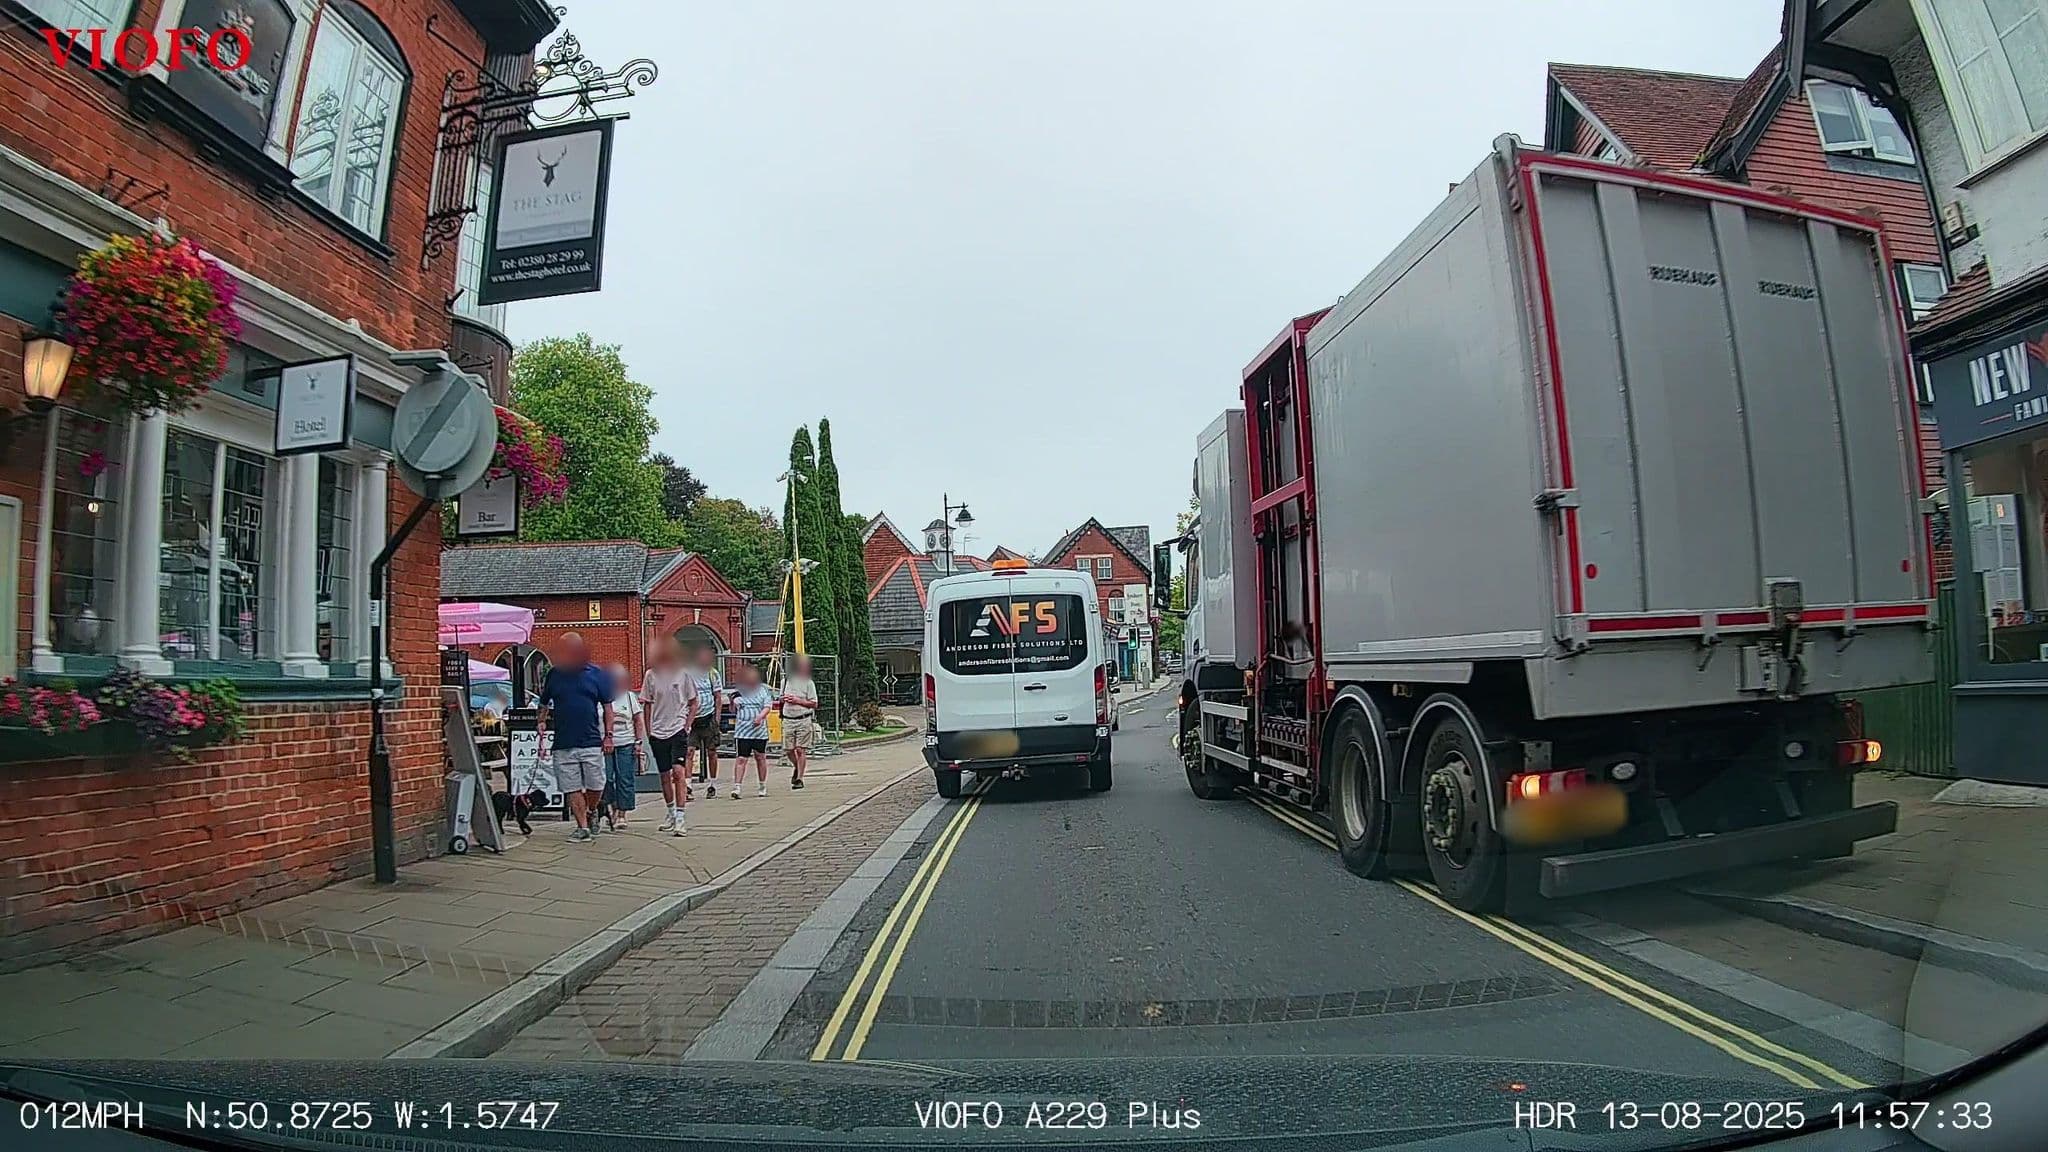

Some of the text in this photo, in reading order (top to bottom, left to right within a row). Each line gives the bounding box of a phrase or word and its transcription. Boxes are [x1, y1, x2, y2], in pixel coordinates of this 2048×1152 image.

[513, 191, 583, 211] THE STAG
[1968, 341, 2031, 407] NEW
[294, 416, 327, 434] Hotel
[477, 511, 497, 523] Bar
[970, 601, 1058, 637] AFS
[946, 644, 989, 652] ANDERSON
[1020, 640, 1066, 648] SOLUTIONS
[513, 733, 538, 742] PLAY
[517, 748, 525, 757] A
